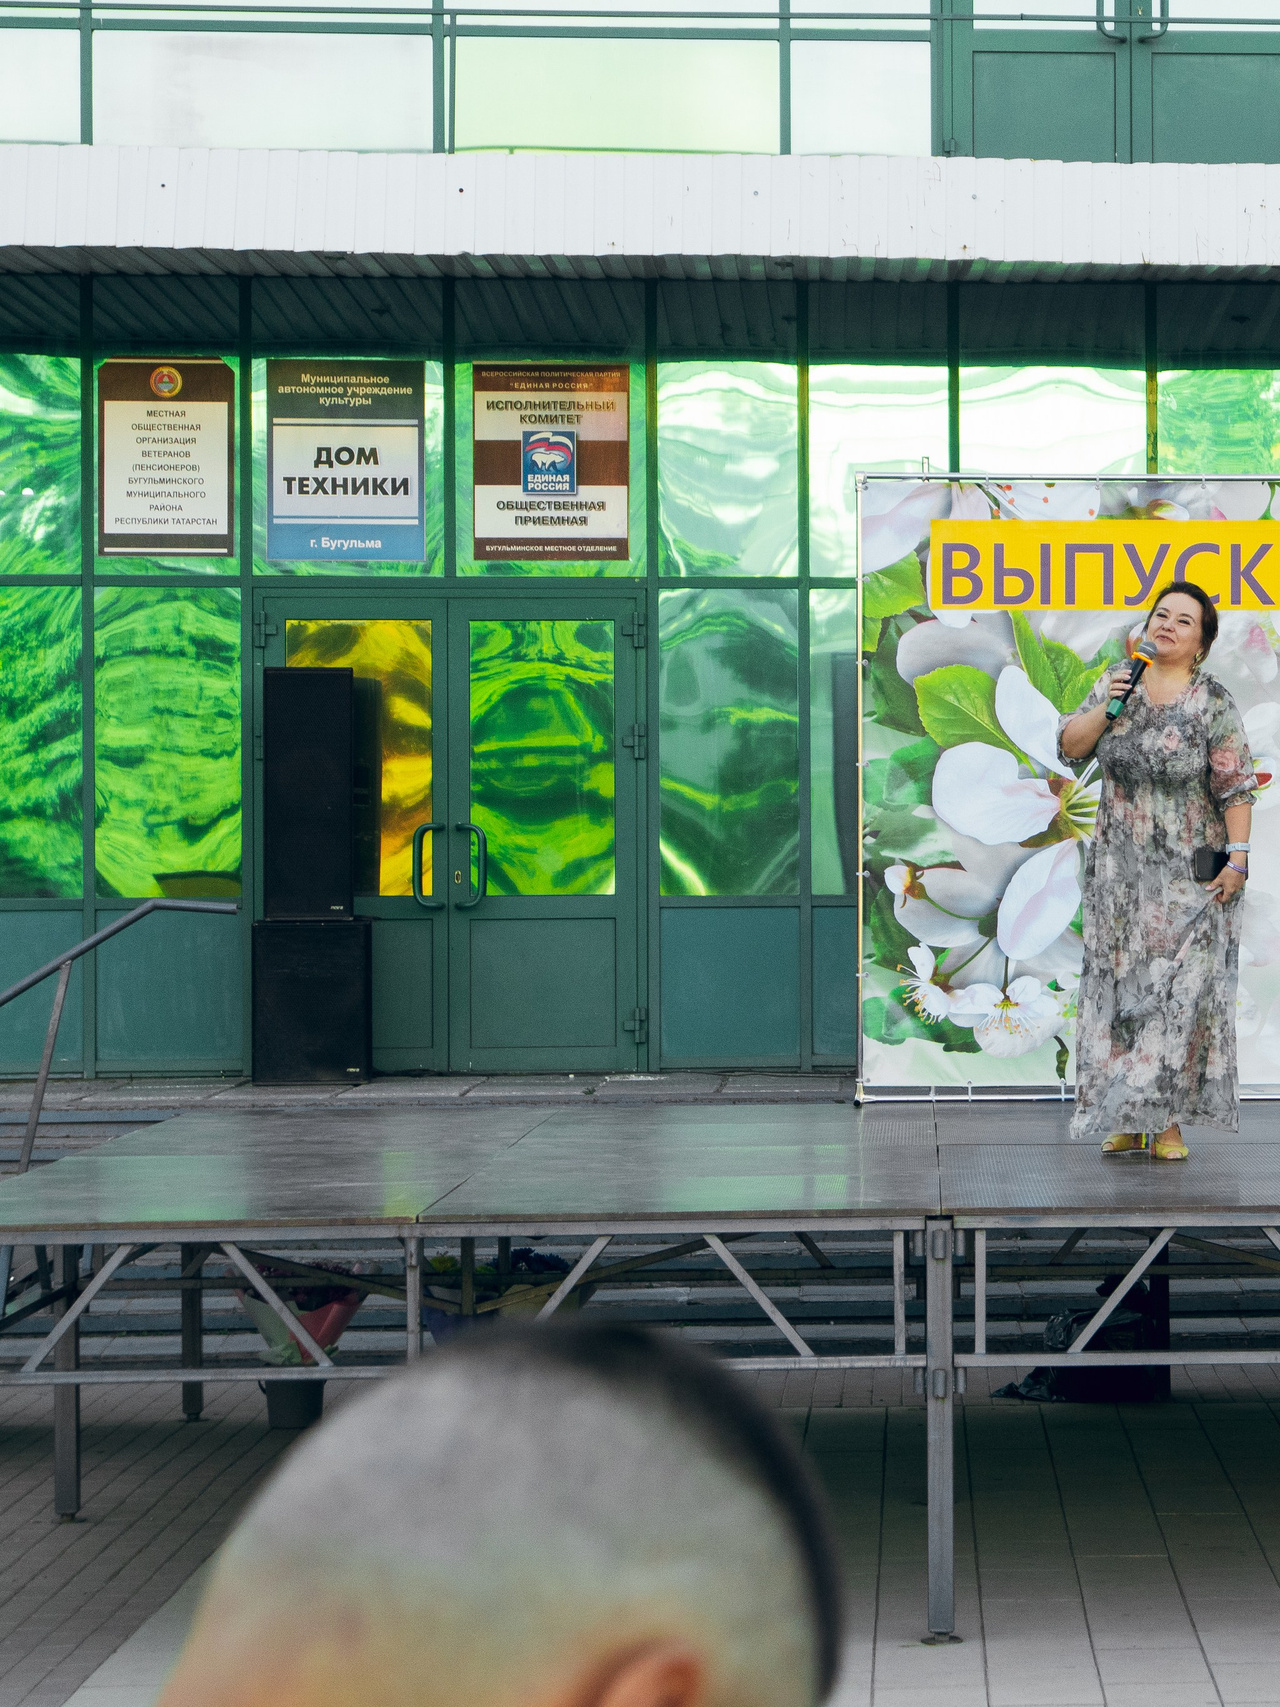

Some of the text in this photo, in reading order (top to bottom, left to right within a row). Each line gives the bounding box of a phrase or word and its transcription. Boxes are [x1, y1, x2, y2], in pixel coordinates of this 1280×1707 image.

[301, 373, 390, 384] Муниципальное
[278, 385, 413, 396] автономное учреждение
[319, 396, 372, 406] культуры
[486, 399, 615, 411] ИСПОЛНИТЕЛЬНЫЙ
[519, 413, 582, 424] КОМИТЕТ
[131, 423, 201, 431] ОБЩЕСТВЕННАЯ
[135, 437, 197, 445] ОРГАНИЗАЦИЯ
[141, 450, 191, 458] ВЕТЕРАНОВ
[314, 446, 379, 469] ДОМ
[132, 464, 200, 472] (ПЕНСИОНЕРОВ)
[128, 477, 205, 485] БУГУЛЬМИНСКОГО
[528, 474, 570, 482] ЕДИНАЯ
[283, 477, 409, 496] ТЕХНИКИ
[528, 483, 570, 491] РОССИЯ
[126, 491, 206, 499] МУНИЦИПАЛЬНОГО
[149, 503, 183, 511] РАЙОНА
[496, 501, 606, 512] ОБЩЕСТВЕННАЯ
[114, 517, 169, 525] РЕСПУБЛИКИ
[514, 516, 588, 526] ПРИЕМНАЯ
[321, 538, 382, 551] Бугульма
